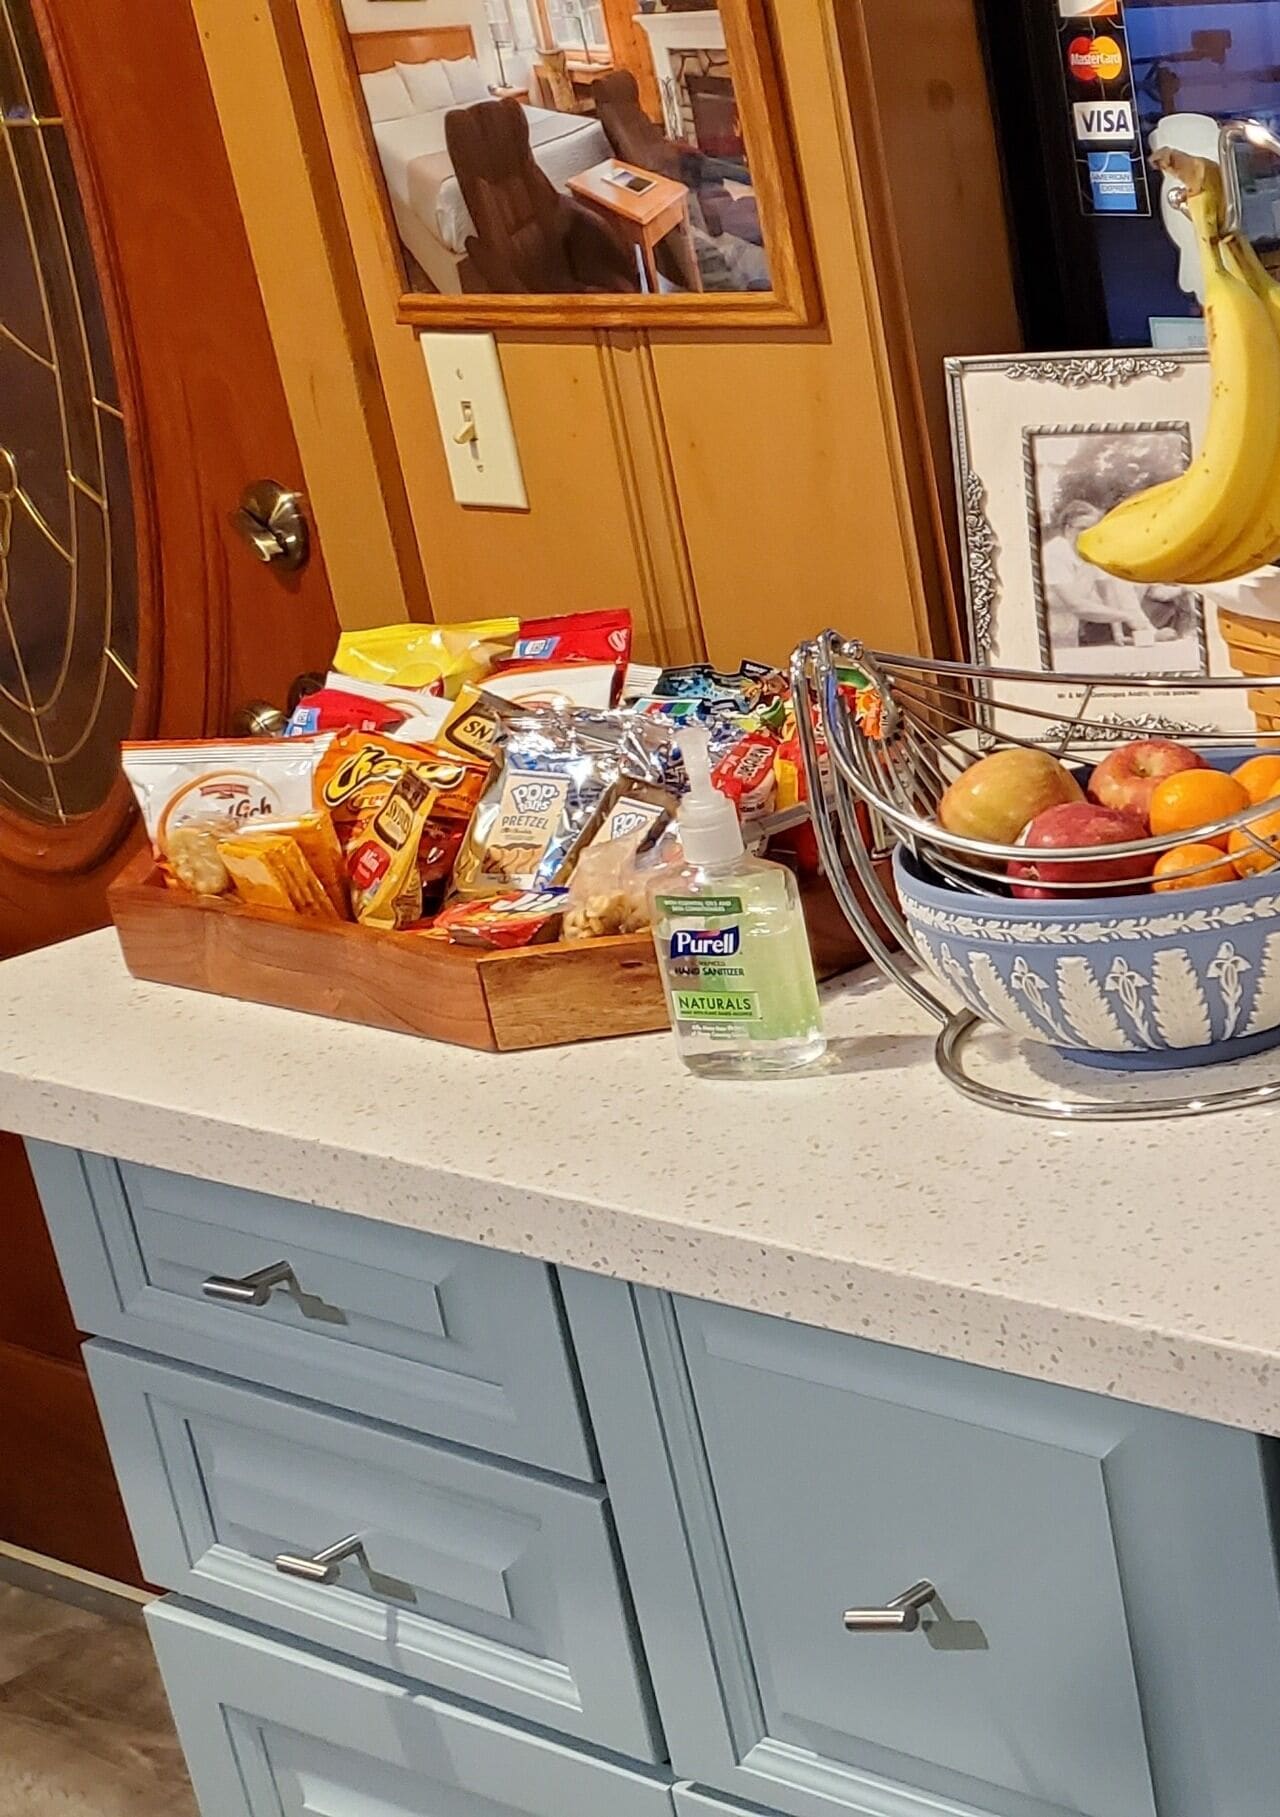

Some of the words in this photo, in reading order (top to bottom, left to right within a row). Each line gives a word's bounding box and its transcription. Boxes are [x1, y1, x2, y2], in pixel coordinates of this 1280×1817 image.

[1071, 53, 1123, 66] MasterCard
[1082, 109, 1130, 133] VISA
[501, 815, 550, 830] PRETZEL
[676, 931, 735, 954] Purell
[702, 967, 745, 977] SANITIZER
[679, 996, 752, 1010] NATURALS
